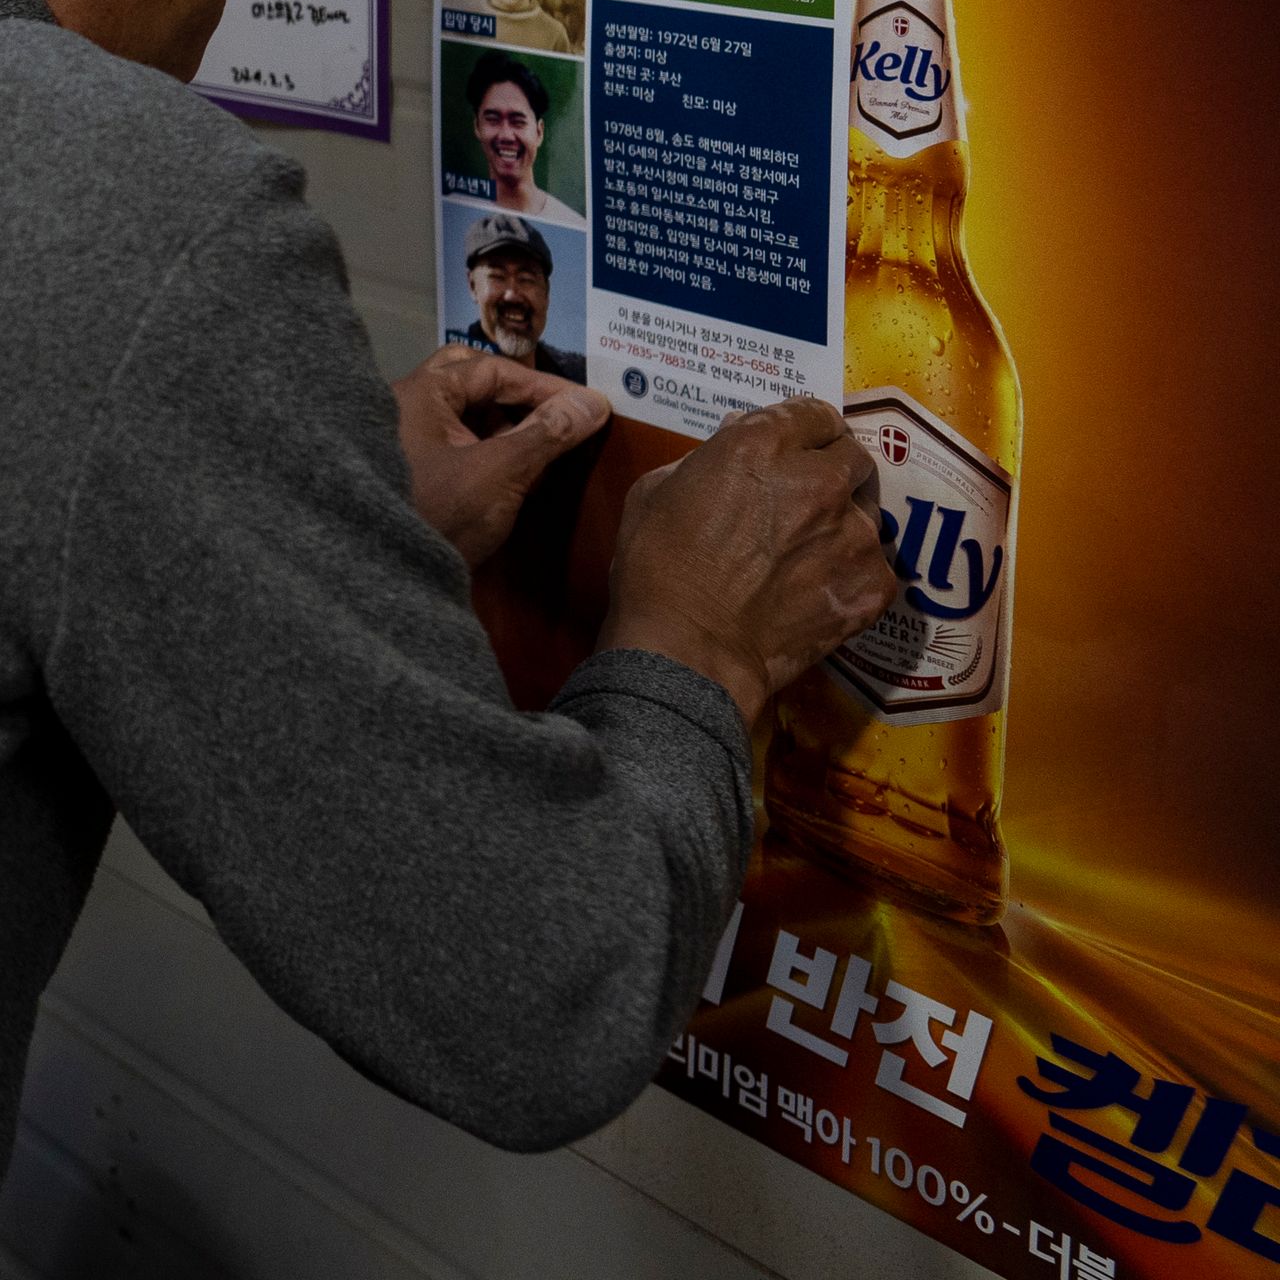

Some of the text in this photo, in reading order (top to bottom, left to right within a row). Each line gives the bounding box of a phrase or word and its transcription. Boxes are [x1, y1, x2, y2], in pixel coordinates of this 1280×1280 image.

[605, 22, 752, 57] 생년월일: 1972년 6월 27일
[605, 43, 667, 65] 출생지: 미상
[604, 62, 682, 87] 발견된 곳: 부산
[851, 41, 951, 101] Kelly
[604, 82, 737, 116] 친부: 미상 친모: 미상
[604, 121, 643, 139] 1978년
[672, 133, 695, 148] 송도
[699, 137, 746, 157] 해변에서
[750, 146, 799, 168] 배회하던
[605, 139, 800, 188] 당시 6세의 상기인을 서부 경찰서에서
[632, 164, 689, 186] 부산시청에
[692, 173, 739, 197] 의뢰하여
[743, 184, 779, 204] 동래구
[723, 221, 747, 238] 통해
[750, 227, 800, 249] 미국으로
[704, 238, 738, 257] 당시에
[743, 246, 766, 263] 거의
[770, 252, 781, 268] 만
[787, 256, 806, 272] 7세
[653, 264, 685, 284] 기억이
[735, 264, 781, 287] 남동생에
[786, 277, 811, 295] 대한
[655, 315, 697, 338] 아시거나
[701, 328, 732, 346] 정보가
[737, 337, 769, 357] 있으신
[773, 347, 796, 364] 분은
[701, 346, 780, 377] 02-325-6585
[784, 368, 806, 385] 또는
[711, 365, 767, 392] 연락주시기
[653, 395, 721, 422] Global Overseas
[879, 495, 1003, 620] lly
[884, 610, 929, 634] MALT
[766, 930, 992, 1130] 반전
[667, 1035, 770, 1118] 리미엄
[776, 1087, 857, 1163] 맥아
